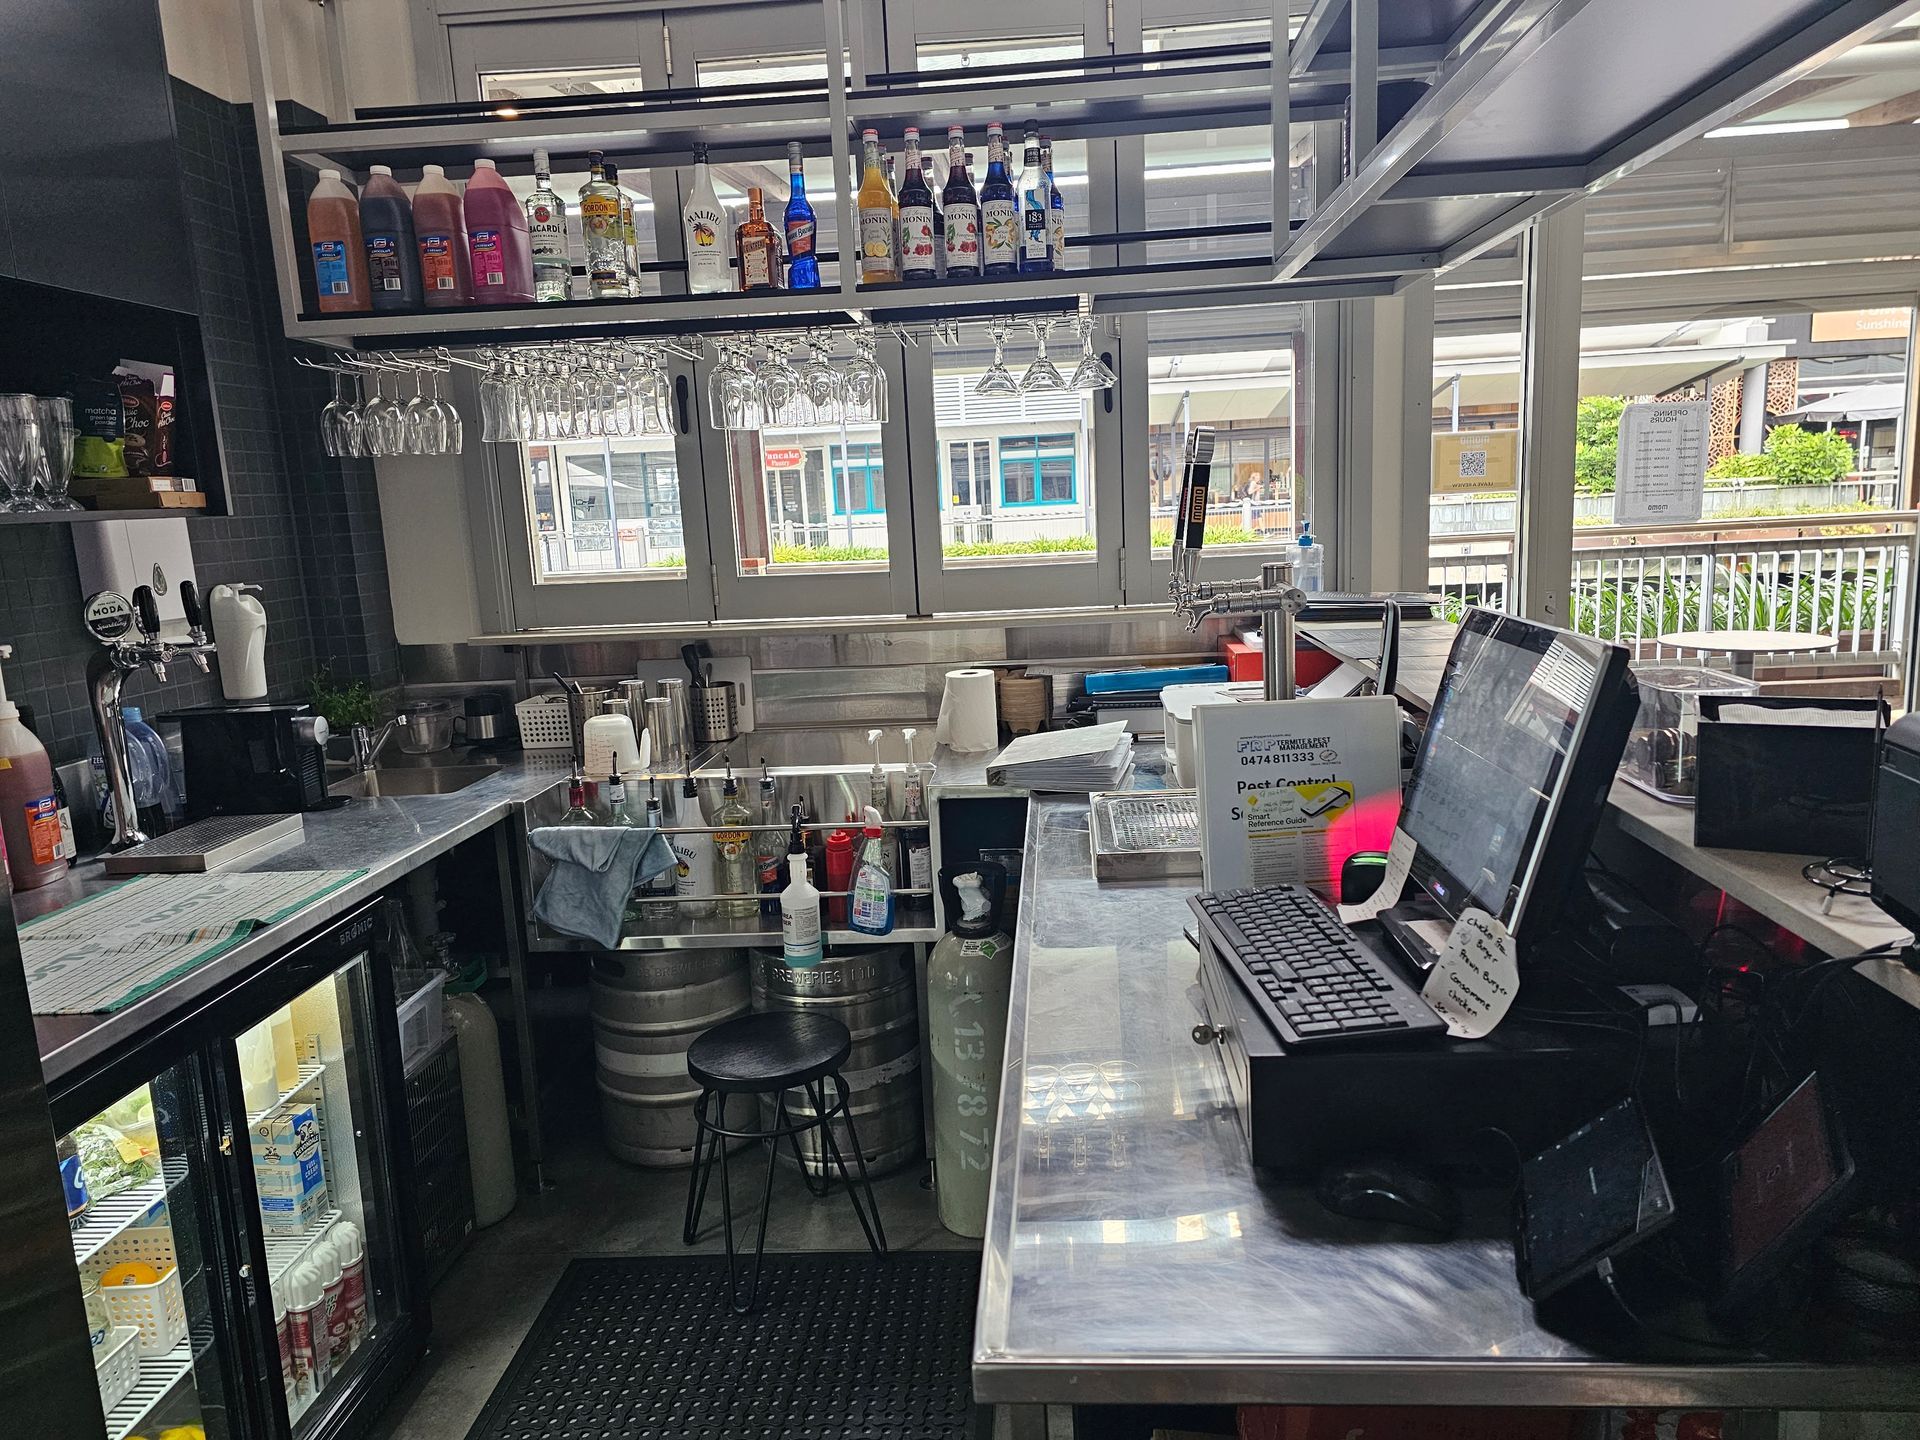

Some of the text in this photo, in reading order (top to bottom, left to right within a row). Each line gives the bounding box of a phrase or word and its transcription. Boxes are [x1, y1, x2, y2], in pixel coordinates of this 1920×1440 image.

[687, 210, 721, 226] MALIBU
[947, 213, 977, 221] MONIN
[985, 208, 1014, 218] MONIN
[902, 216, 931, 224] MONIN
[85, 407, 117, 415] matcha
[92, 604, 124, 616] MODA
[1236, 738, 1277, 753] FRP
[1277, 738, 1307, 746] TERMITE
[1279, 742, 1329, 751] MANAGEMENT
[1237, 780, 1272, 794] Pest
[1247, 813, 1271, 821] Smart
[1247, 817, 1307, 828] Reference Guide
[771, 967, 842, 985] BREWERIES
